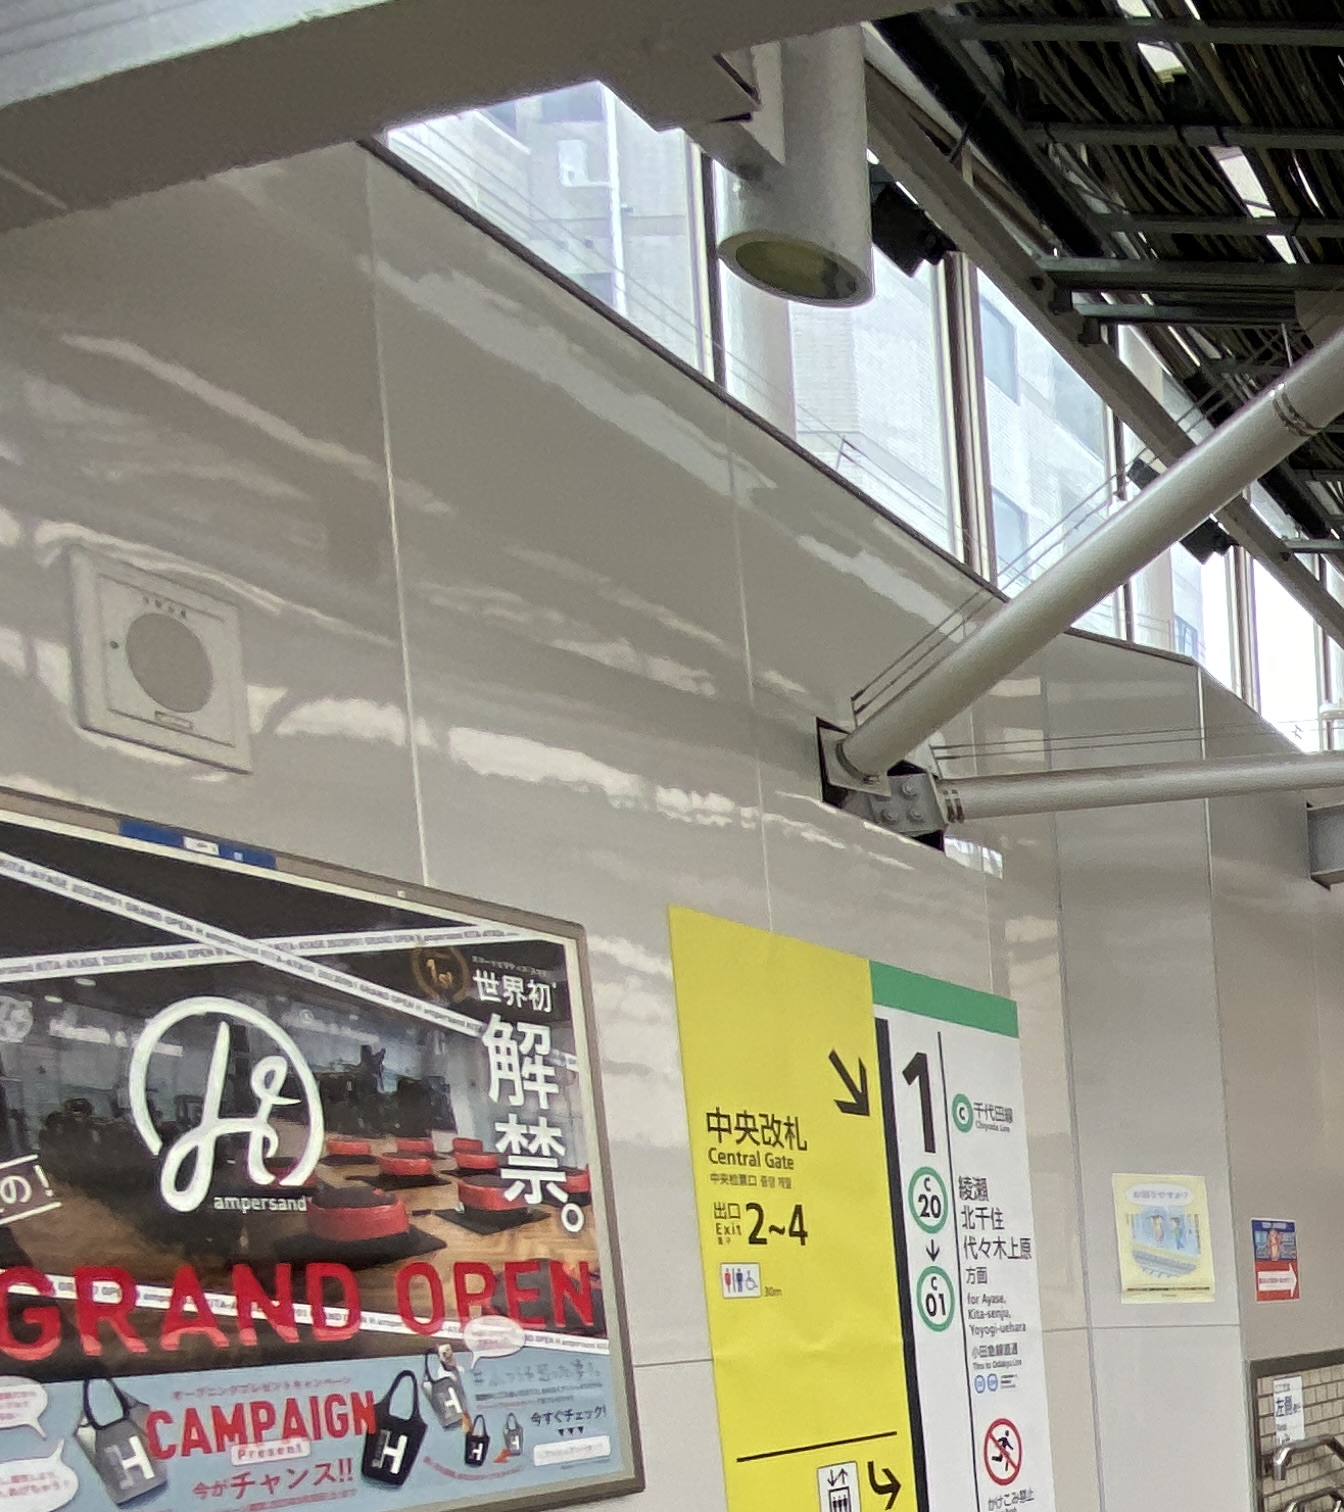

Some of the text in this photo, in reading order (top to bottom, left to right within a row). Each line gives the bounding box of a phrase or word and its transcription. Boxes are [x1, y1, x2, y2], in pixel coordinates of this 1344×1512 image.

[473, 969, 552, 1013] 世界初
[902, 1052, 936, 1154] 1
[973, 1102, 1013, 1123] 千代田線
[482, 1013, 584, 1233] 解禁。
[706, 1107, 807, 1151] 中央改札
[708, 1148, 794, 1170] Central Gate
[213, 1195, 308, 1213] ampersand
[714, 1202, 741, 1219] 出口
[918, 1194, 941, 1218] 20
[716, 1222, 742, 1236] Exit
[961, 1205, 1005, 1230] 北千住
[963, 1235, 1032, 1260] 代々木上原
[965, 1266, 988, 1284] 方面
[0, 1260, 594, 1361] GRAND OPEN
[925, 1293, 946, 1317] 01
[967, 1292, 979, 1305] for
[969, 1322, 1026, 1338] Yoyogi-uehara
[146, 1390, 377, 1461] CAMPAIGN
[988, 1488, 1034, 1511] かけこみ禁止
